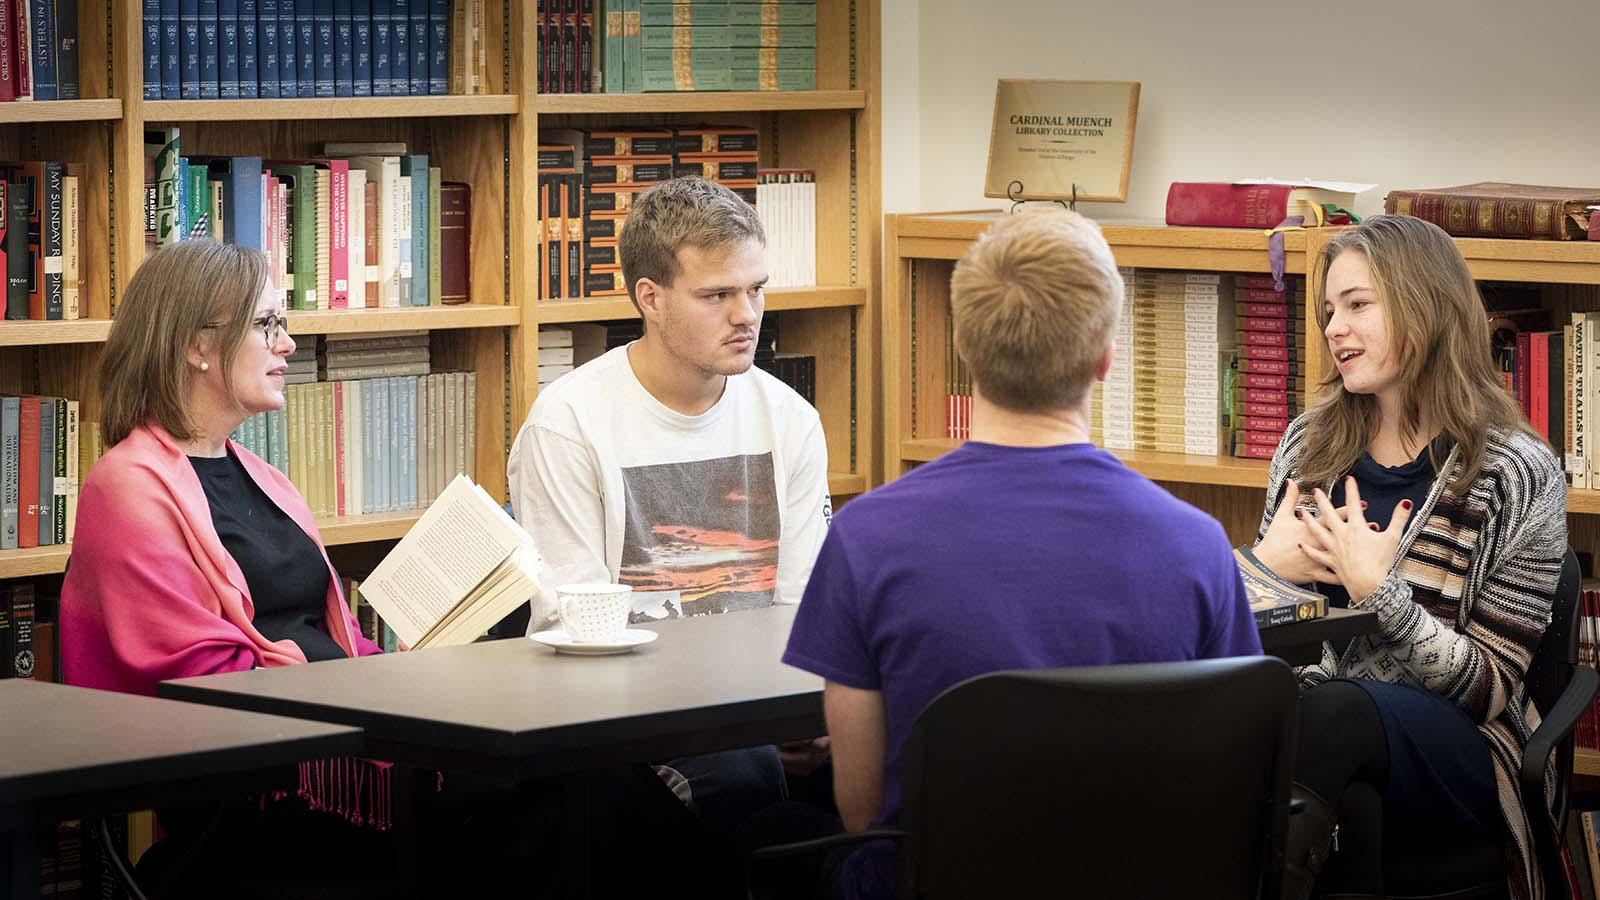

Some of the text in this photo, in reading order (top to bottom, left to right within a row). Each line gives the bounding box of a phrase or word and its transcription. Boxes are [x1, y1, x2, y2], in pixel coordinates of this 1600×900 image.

[37, 20, 47, 66] SISTERS
[1010, 114, 1112, 127] CARDINAL MUENCH
[1016, 128, 1051, 136] LIBRARY
[334, 172, 340, 182] TO
[51, 172, 62, 304] MY SUNDAY RDING
[272, 416, 280, 444] Theology
